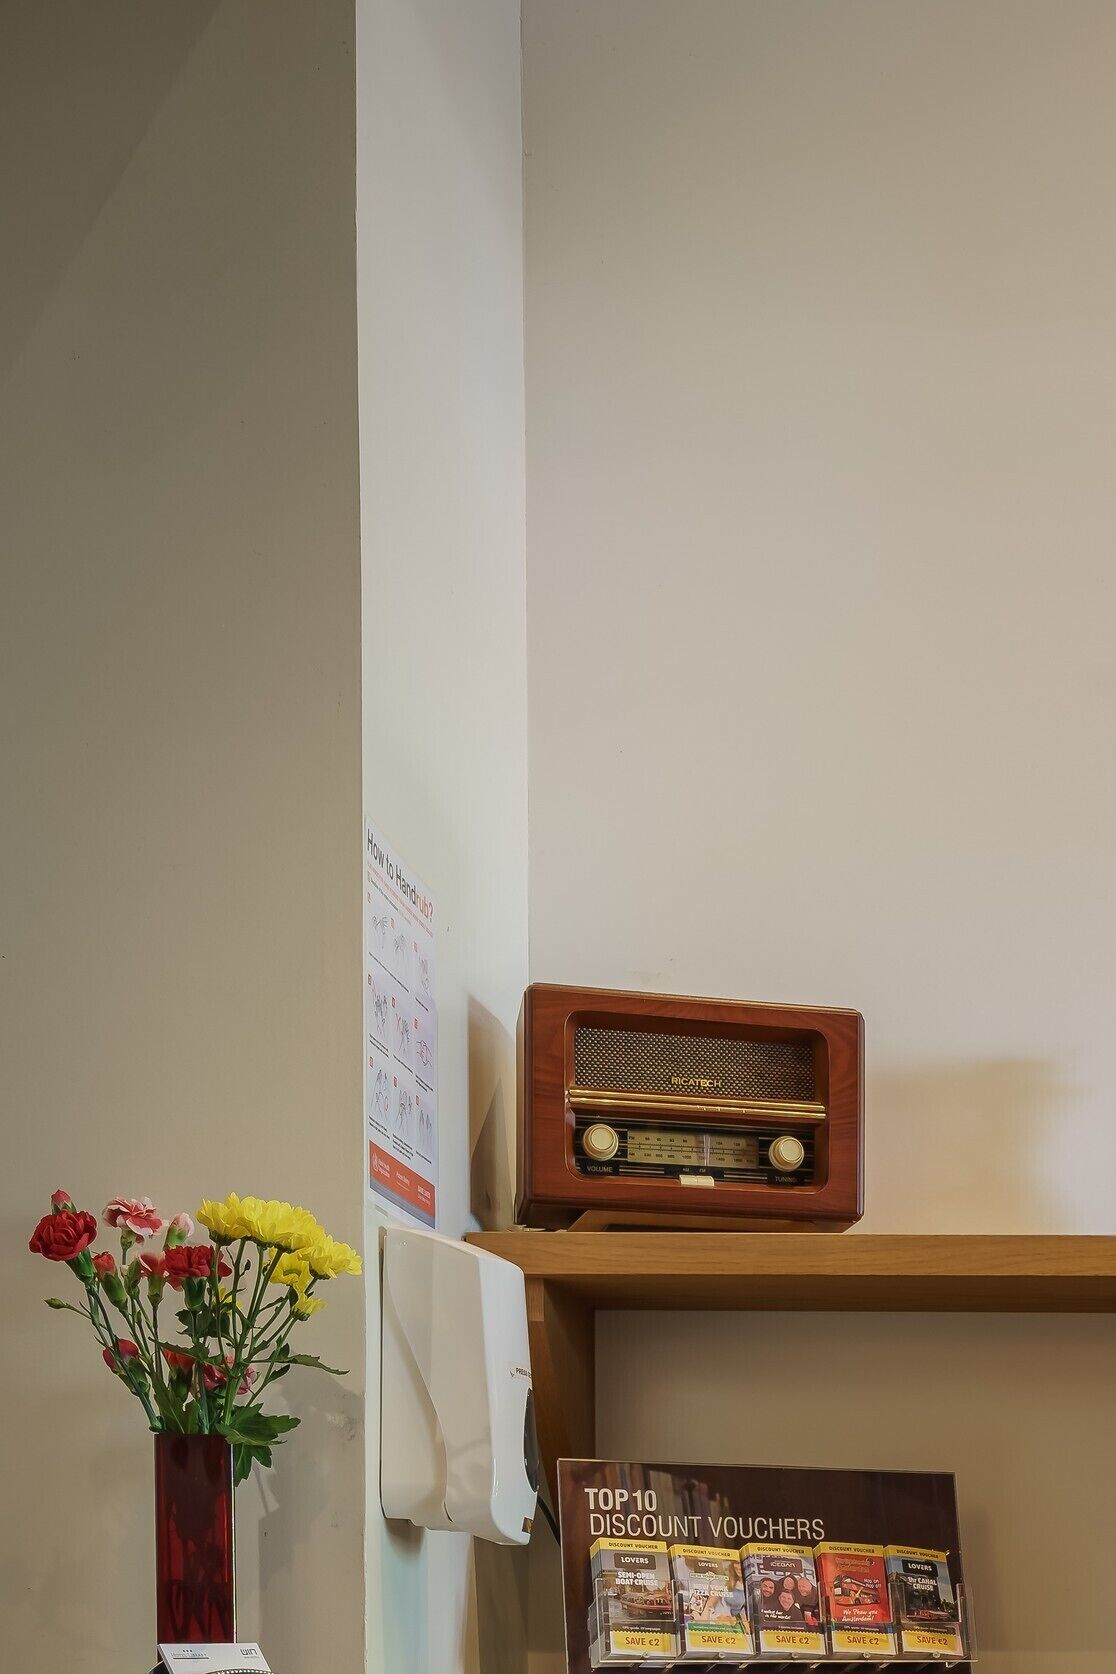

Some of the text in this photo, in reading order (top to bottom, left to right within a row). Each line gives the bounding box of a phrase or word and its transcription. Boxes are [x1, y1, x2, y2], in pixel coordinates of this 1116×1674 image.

[366, 828, 385, 869] How
[386, 854, 394, 881] to
[395, 864, 434, 923] Handrub?
[671, 1076, 722, 1088] RICATECH
[587, 1165, 613, 1173] VOLUME
[584, 1487, 657, 1512] TOP 10
[589, 1514, 825, 1541] DISCOUNT VOUCHERS
[608, 1541, 634, 1549] DISCOUNT
[621, 1556, 649, 1564] LOVERS
[698, 1561, 719, 1569] LOVERS
[908, 1563, 933, 1571] LOVERS
[617, 1571, 655, 1580] SEMI-OPEN
[917, 1577, 937, 1586] CANAL
[912, 1583, 934, 1592] CRUISE
[625, 1636, 660, 1646] SAVE €2
[701, 1635, 736, 1645] SAVE €2
[776, 1635, 810, 1645] SAVE €2
[847, 1636, 880, 1645] SAVE €2
[917, 1636, 948, 1645] SAVE €2
